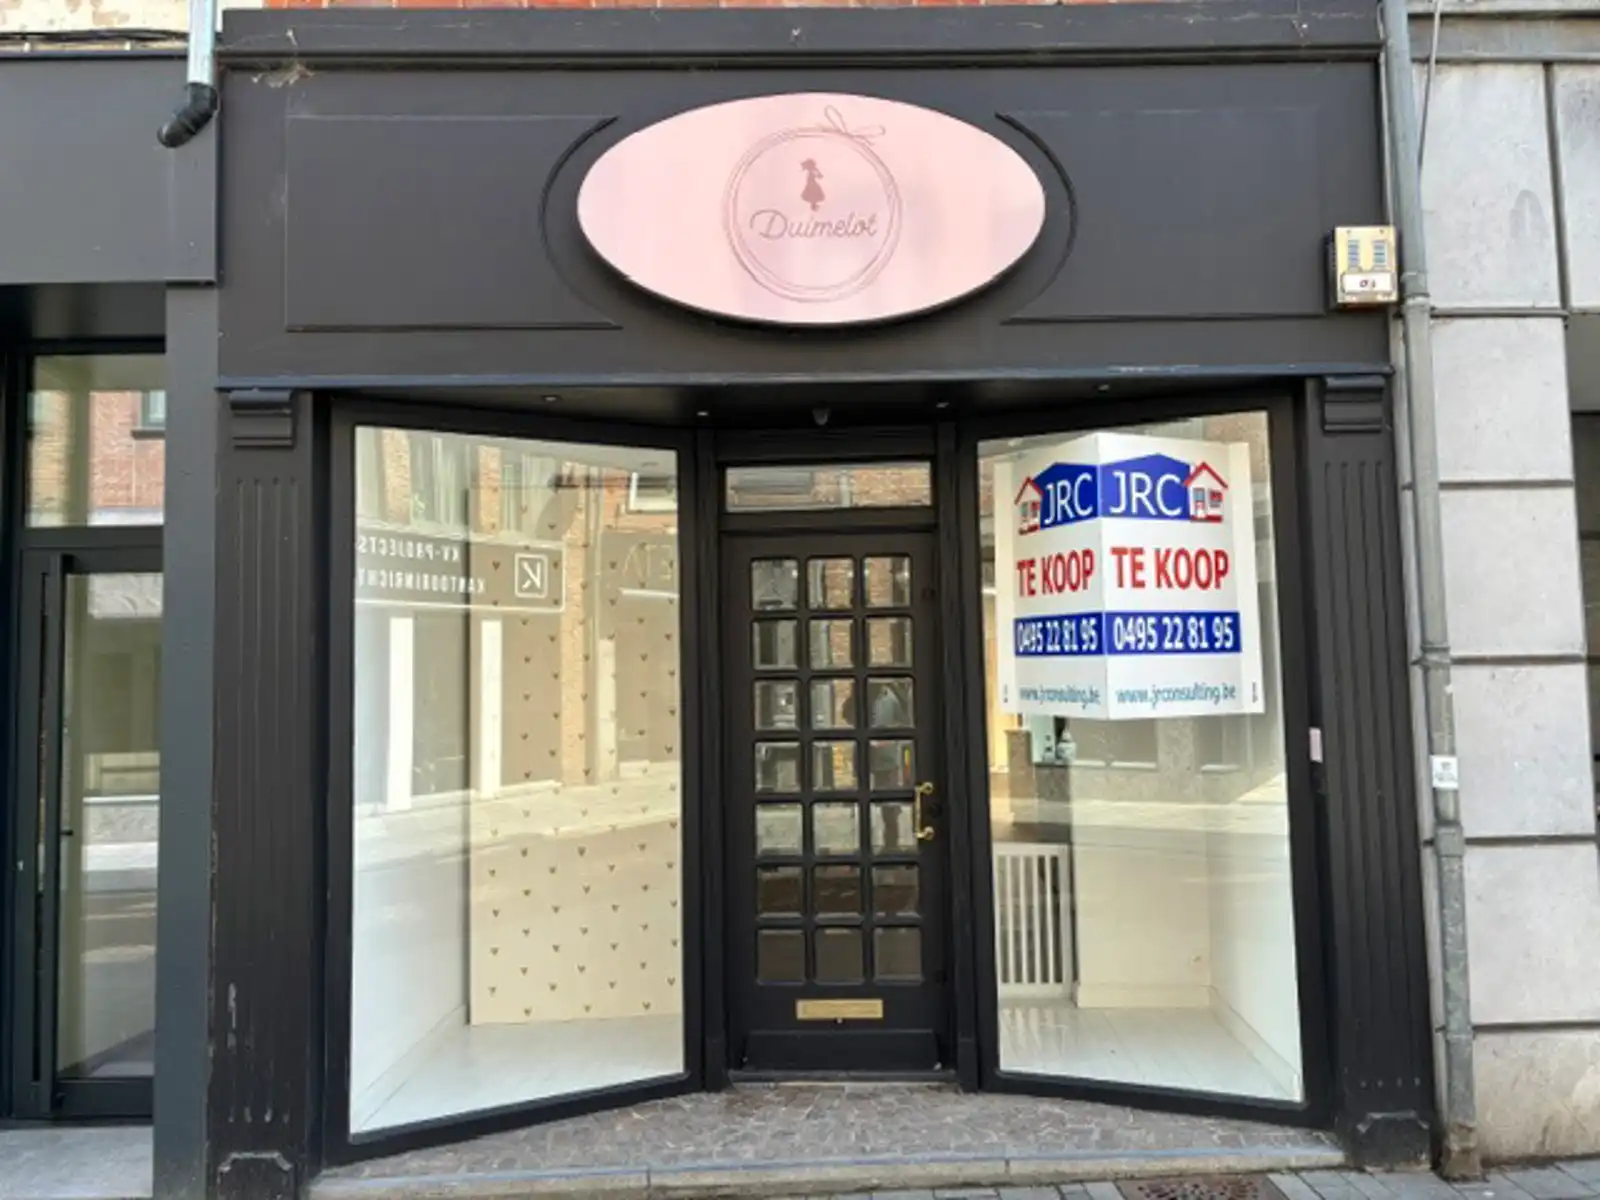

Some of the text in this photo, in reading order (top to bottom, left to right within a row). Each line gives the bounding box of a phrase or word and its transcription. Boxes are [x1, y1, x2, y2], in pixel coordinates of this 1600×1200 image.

[750, 208, 877, 240] Duimelot
[1044, 472, 1092, 525] JRC
[1110, 471, 1183, 516] JRC
[1016, 549, 1095, 597] TE KOOP
[1110, 547, 1229, 590] TE KOOP
[1017, 617, 1099, 653] 0495 22 81 95
[1113, 616, 1233, 650] 0495 22 81 95
[1116, 682, 1236, 708] www.jrconsulting.be
